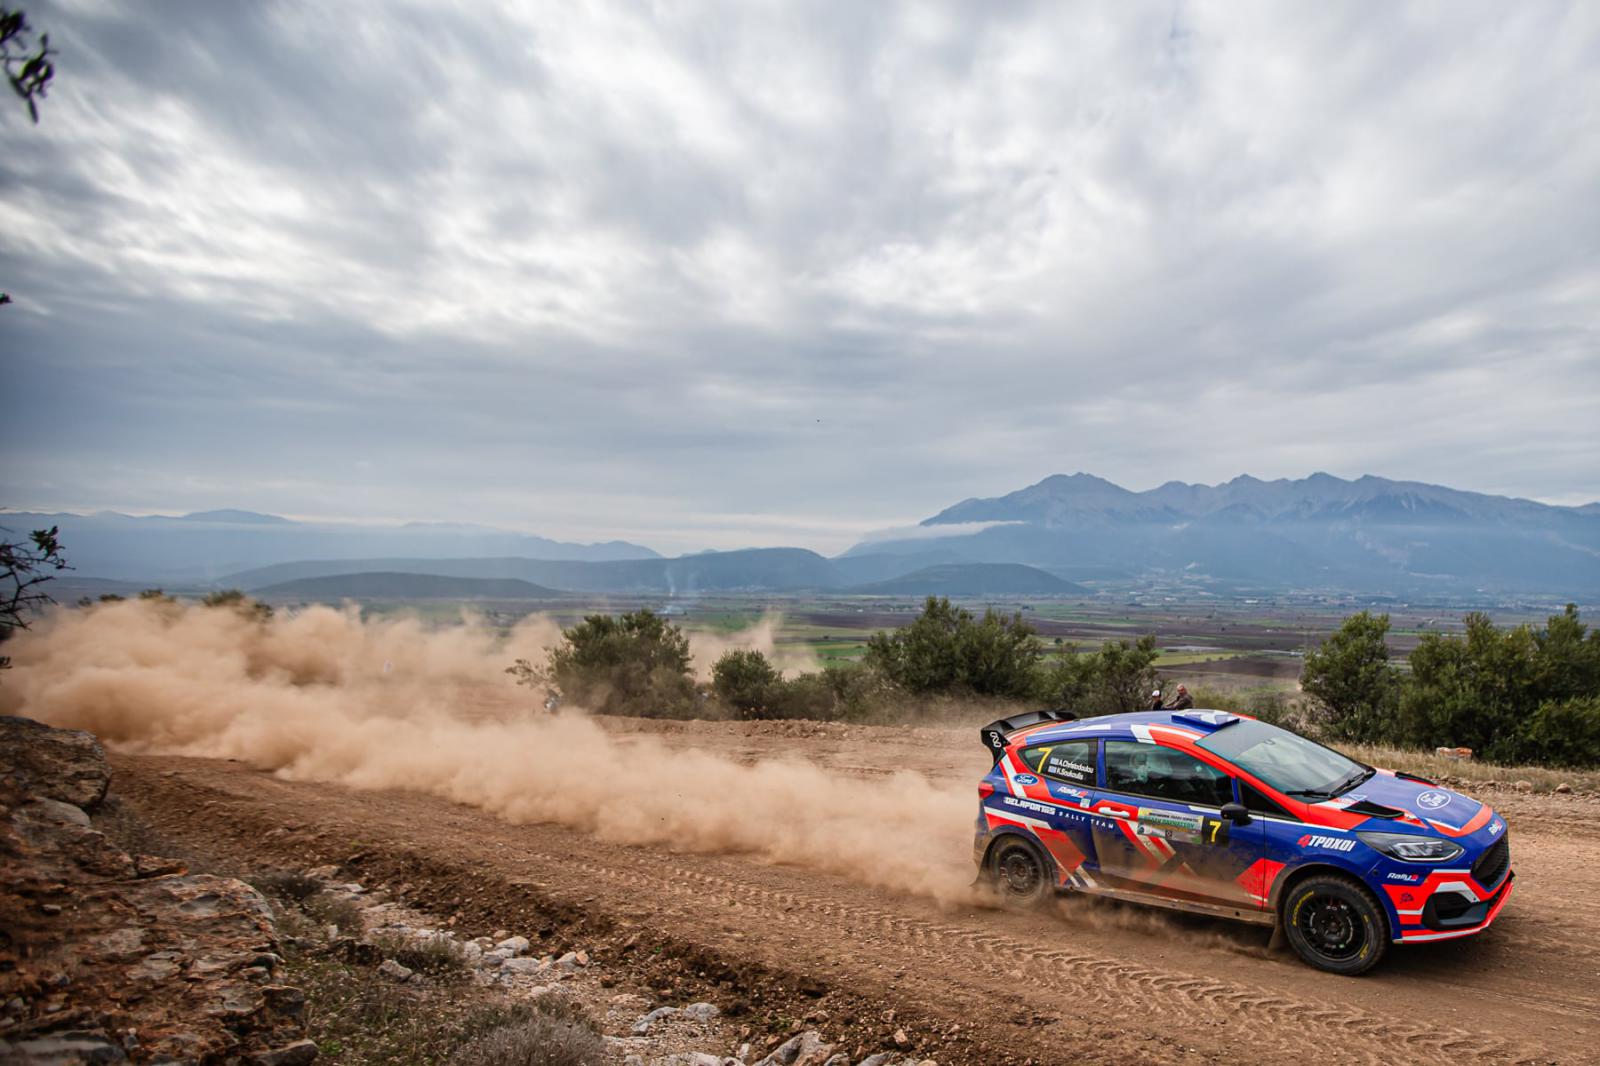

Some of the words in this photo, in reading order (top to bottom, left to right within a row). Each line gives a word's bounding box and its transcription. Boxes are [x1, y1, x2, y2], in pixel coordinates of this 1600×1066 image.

[1038, 747, 1053, 773] 7
[1059, 811, 1085, 822] RALLY
[1091, 819, 1114, 829] TEAM
[1209, 820, 1221, 843] 7
